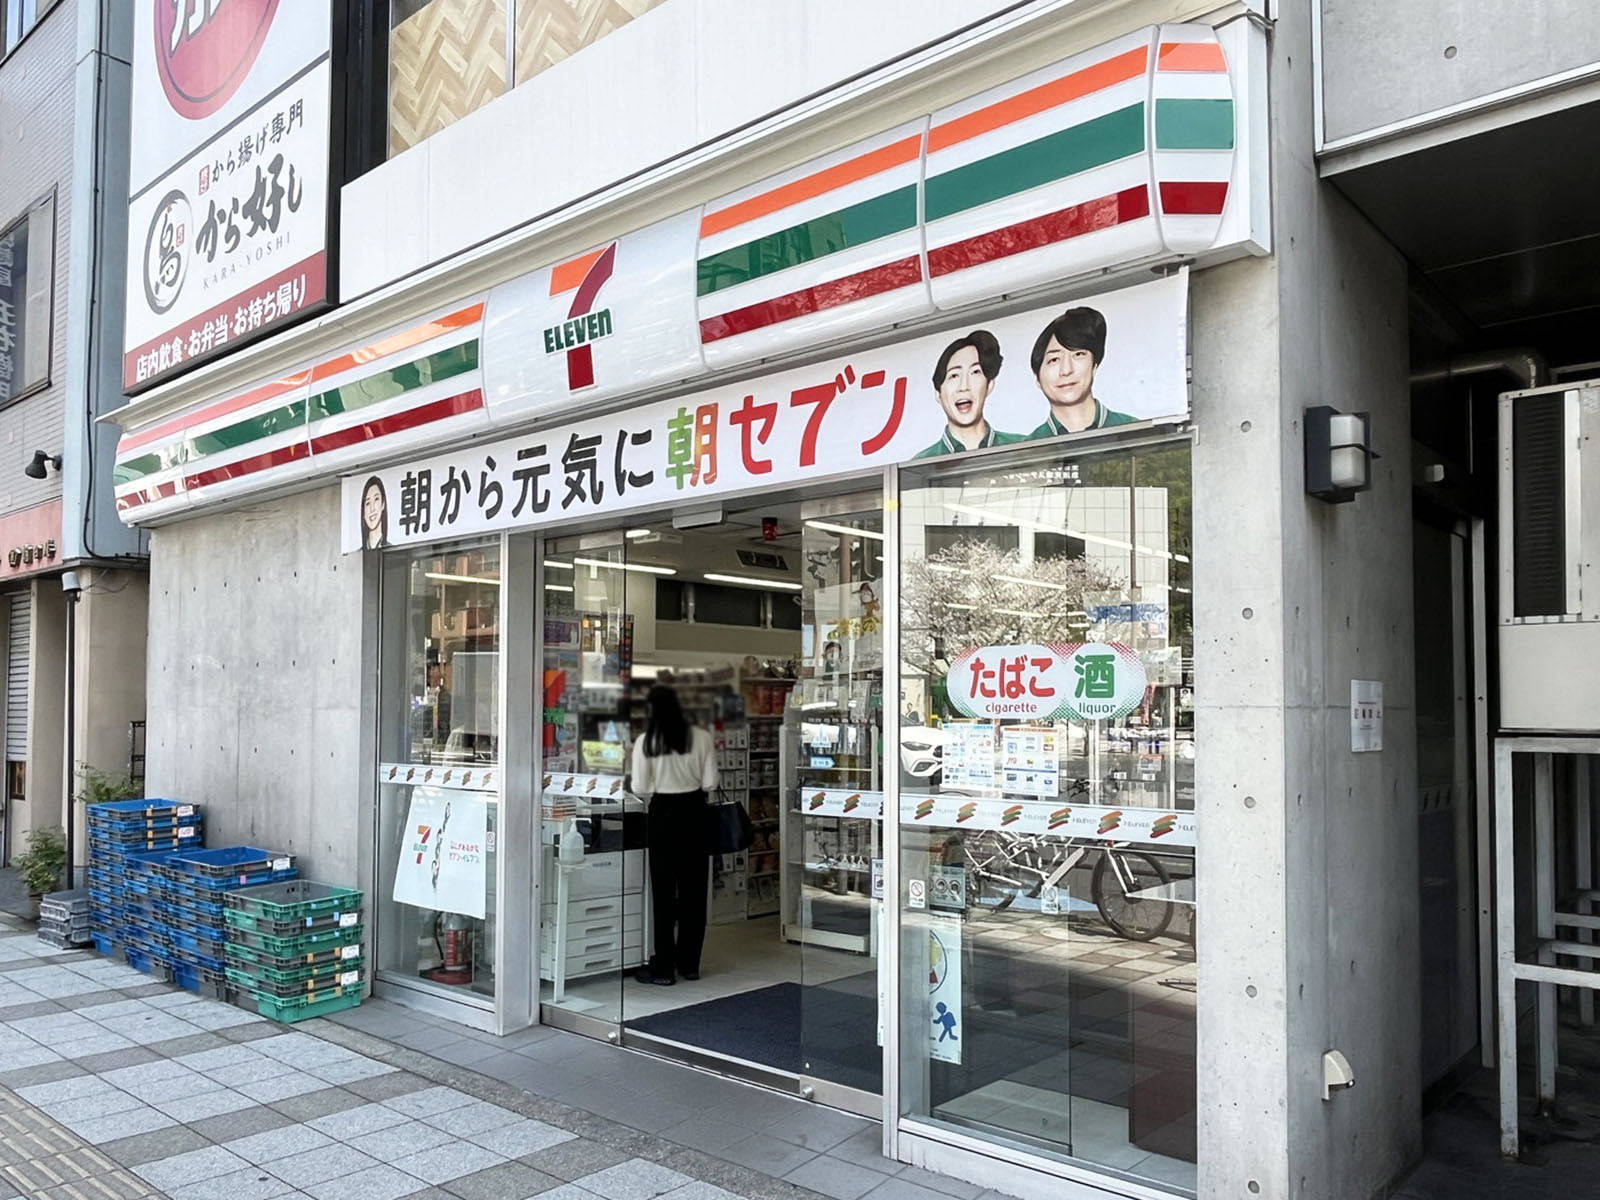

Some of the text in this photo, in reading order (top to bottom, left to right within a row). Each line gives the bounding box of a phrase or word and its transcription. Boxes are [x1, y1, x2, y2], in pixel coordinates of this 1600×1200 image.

[212, 99, 304, 183] から揚げ専門
[196, 153, 303, 263] から好し
[203, 231, 291, 290] KARA-YOSHI
[399, 364, 908, 537] 朝から元気に朝セブン
[969, 654, 1055, 699] たばこ
[1074, 654, 1115, 699] 酒
[985, 702, 1037, 715] cigarette
[1078, 702, 1116, 714] liquor
